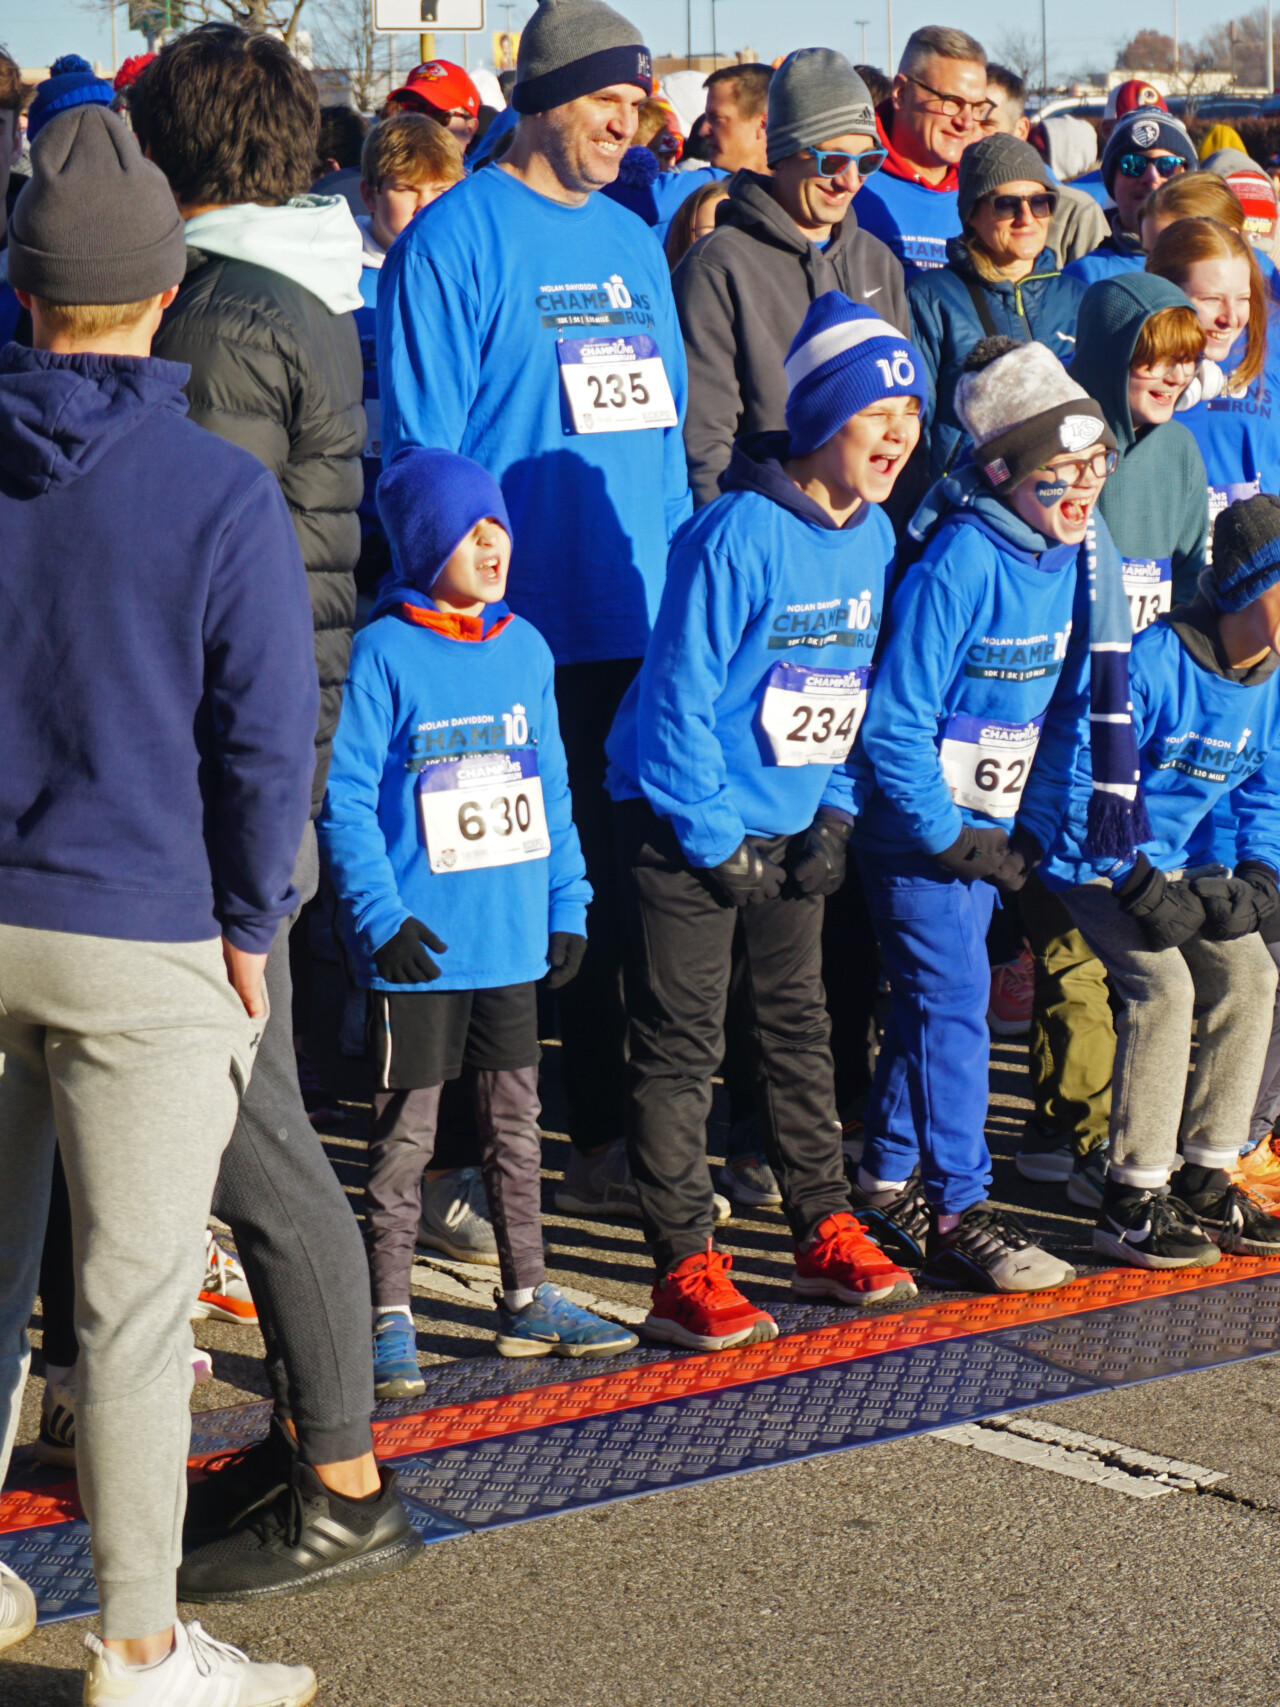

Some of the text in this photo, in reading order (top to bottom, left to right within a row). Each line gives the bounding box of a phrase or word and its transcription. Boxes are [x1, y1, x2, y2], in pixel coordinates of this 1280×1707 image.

[540, 284, 564, 293] NOLAN
[624, 312, 655, 327] RUN
[875, 357, 915, 388] 10
[587, 371, 650, 409] 235
[1231, 400, 1272, 420] RUN
[787, 604, 816, 612] NOLAN
[857, 633, 876, 648] RU
[982, 636, 1014, 646] NOLAN
[418, 714, 494, 732] NOLAN DAVIDSON
[786, 705, 856, 743] 234
[1188, 730, 1231, 749] DAVIDSON
[975, 756, 1031, 793] 62
[1193, 768, 1207, 778] 1.10
[1208, 773, 1225, 782] MILE
[458, 793, 531, 841] 630
